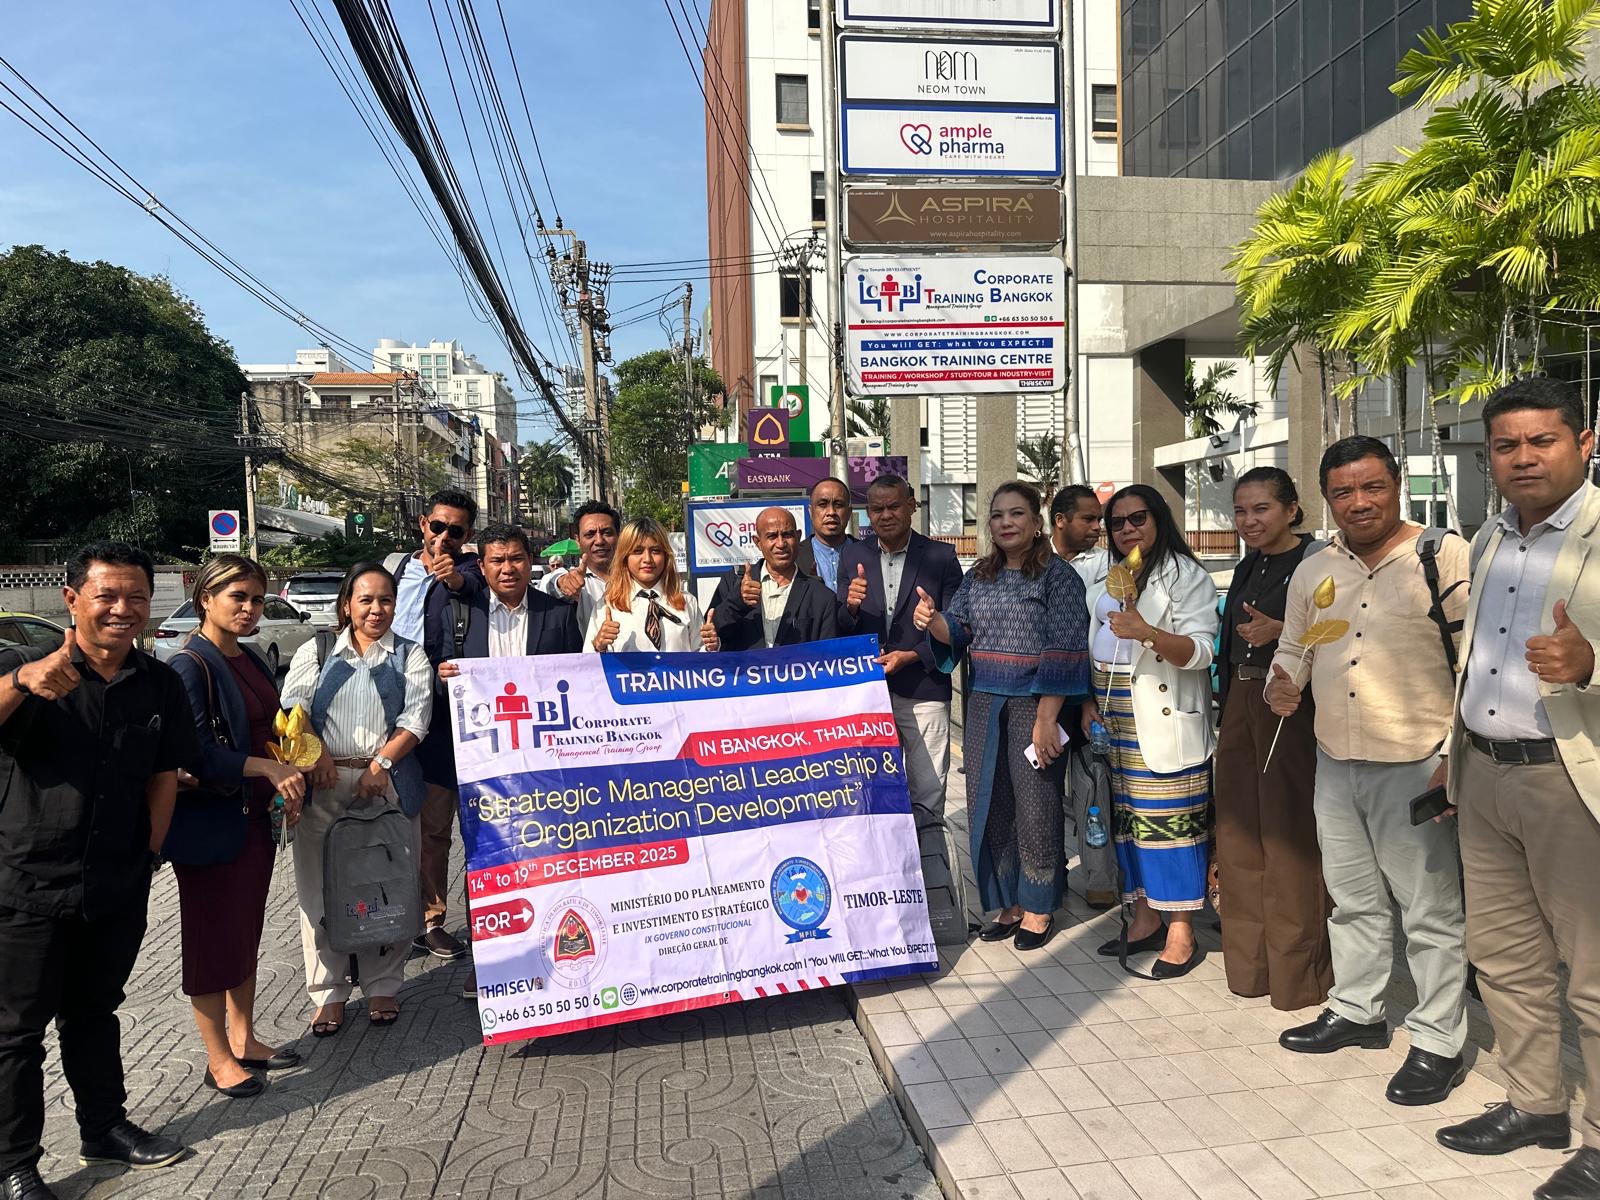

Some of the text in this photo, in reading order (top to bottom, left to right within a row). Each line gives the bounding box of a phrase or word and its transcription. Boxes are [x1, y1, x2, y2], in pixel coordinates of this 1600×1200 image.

[917, 84, 986, 95] NEOM TOWN
[939, 123, 992, 141] ample
[939, 138, 1004, 156] pharma
[920, 197, 1033, 212] ASPIRA
[919, 215, 1034, 224] HOSPITALITY
[929, 230, 1022, 238] www.aspirahospitality.com
[973, 269, 1054, 285] CORPORATE
[924, 287, 1053, 304] TRAINING BANGKOK
[860, 353, 1053, 367] BANGKOK TRAINING CENTRE
[747, 474, 791, 484] EASYBANK
[616, 654, 875, 694] TRAINING / STUDY-VISIT
[571, 715, 652, 730] CORPORATE
[543, 729, 663, 747] TRAINING BANGKOK
[698, 721, 895, 757] IN BANGKOK, THAILAND
[545, 742, 662, 760] Management Training Group
[608, 767, 747, 804] Managerial
[751, 752, 877, 789] Leadership
[882, 751, 900, 774] &
[521, 807, 690, 849] Organization
[496, 873, 511, 888] to
[543, 851, 635, 878] DECEMBER
[639, 846, 677, 863] 2025
[610, 892, 672, 913] MINISTÉRIO
[674, 890, 689, 903] DO
[692, 879, 766, 900] PLANEAMENTO
[843, 889, 923, 909] TIMOR-LESTE
[475, 912, 511, 934] FOR
[613, 924, 620, 935] E
[622, 911, 699, 934] INVESTIMENTO
[701, 898, 770, 919] ESTRATÉGICO
[644, 919, 753, 944] IX GOVERNO CONSTITUCIONAL
[799, 930, 817, 939] MPIE
[658, 937, 729, 956] DIREÇÃO GERAL DE
[640, 961, 803, 997] www.corporatetrainingbangkok.com
[829, 953, 845, 963] Will
[889, 945, 907, 955] You
[907, 943, 929, 954] EXPECT
[498, 993, 600, 1023] +66 63 50 50 50 6
